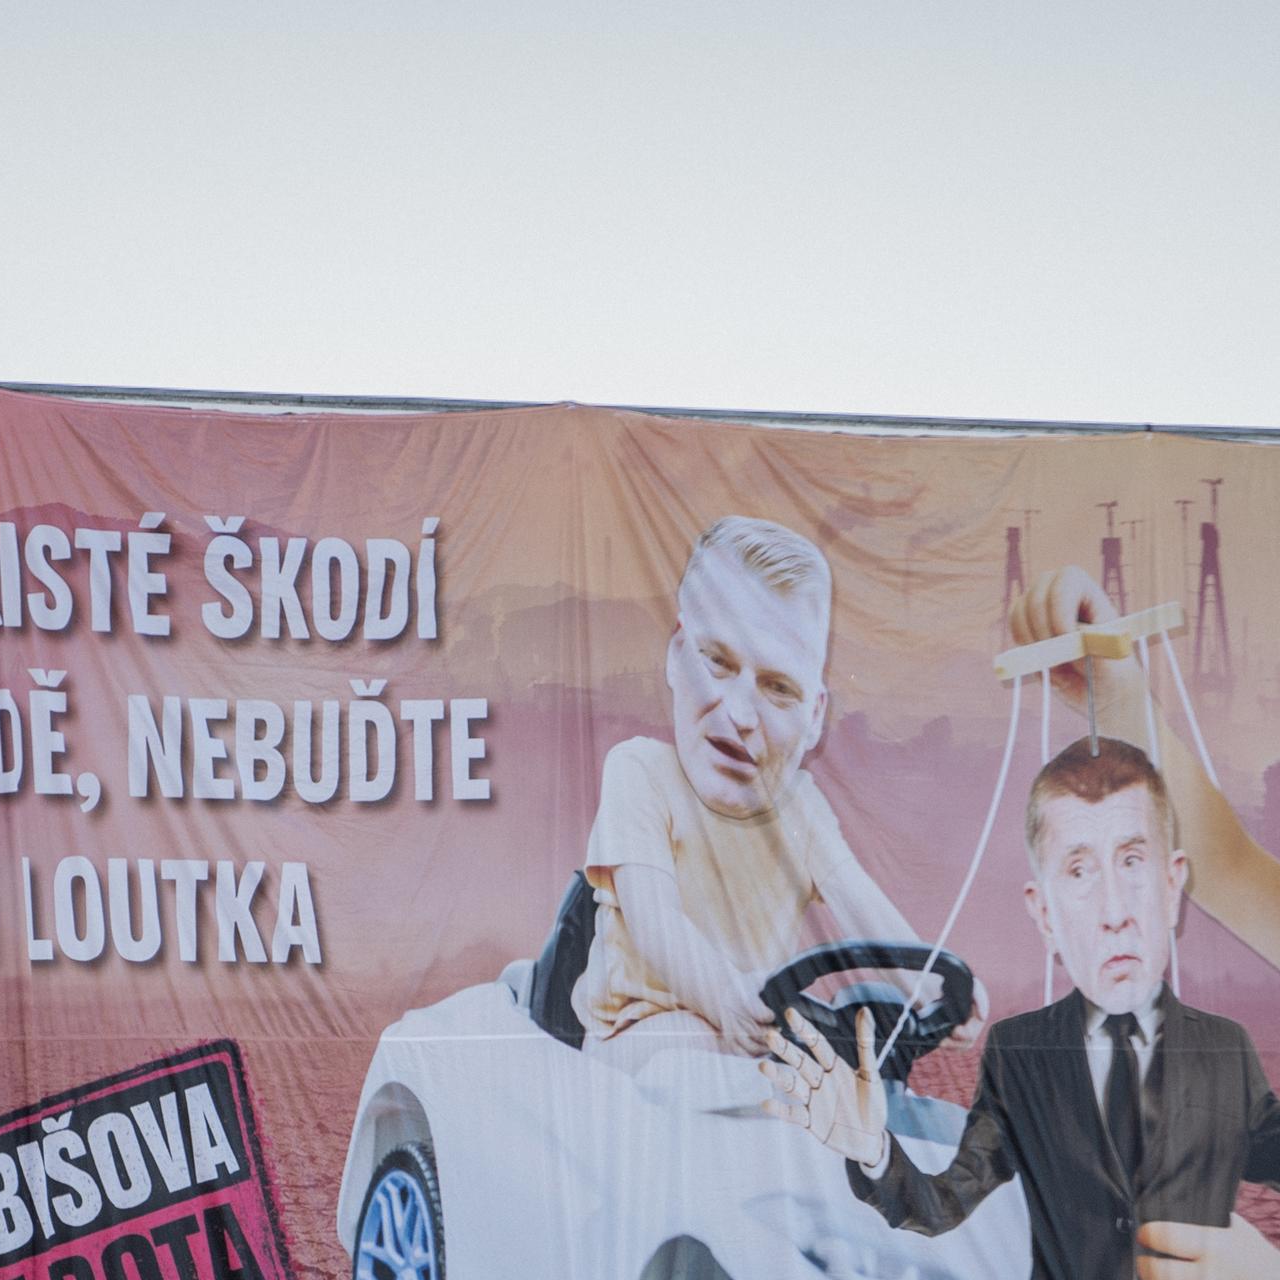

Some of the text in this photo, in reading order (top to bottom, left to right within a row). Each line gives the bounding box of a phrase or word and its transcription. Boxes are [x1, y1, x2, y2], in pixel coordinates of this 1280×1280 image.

[201, 514, 442, 642] ŠKODÍ
[127, 678, 492, 804] NEBUĎTE
[22, 854, 322, 966] LOUTKA
